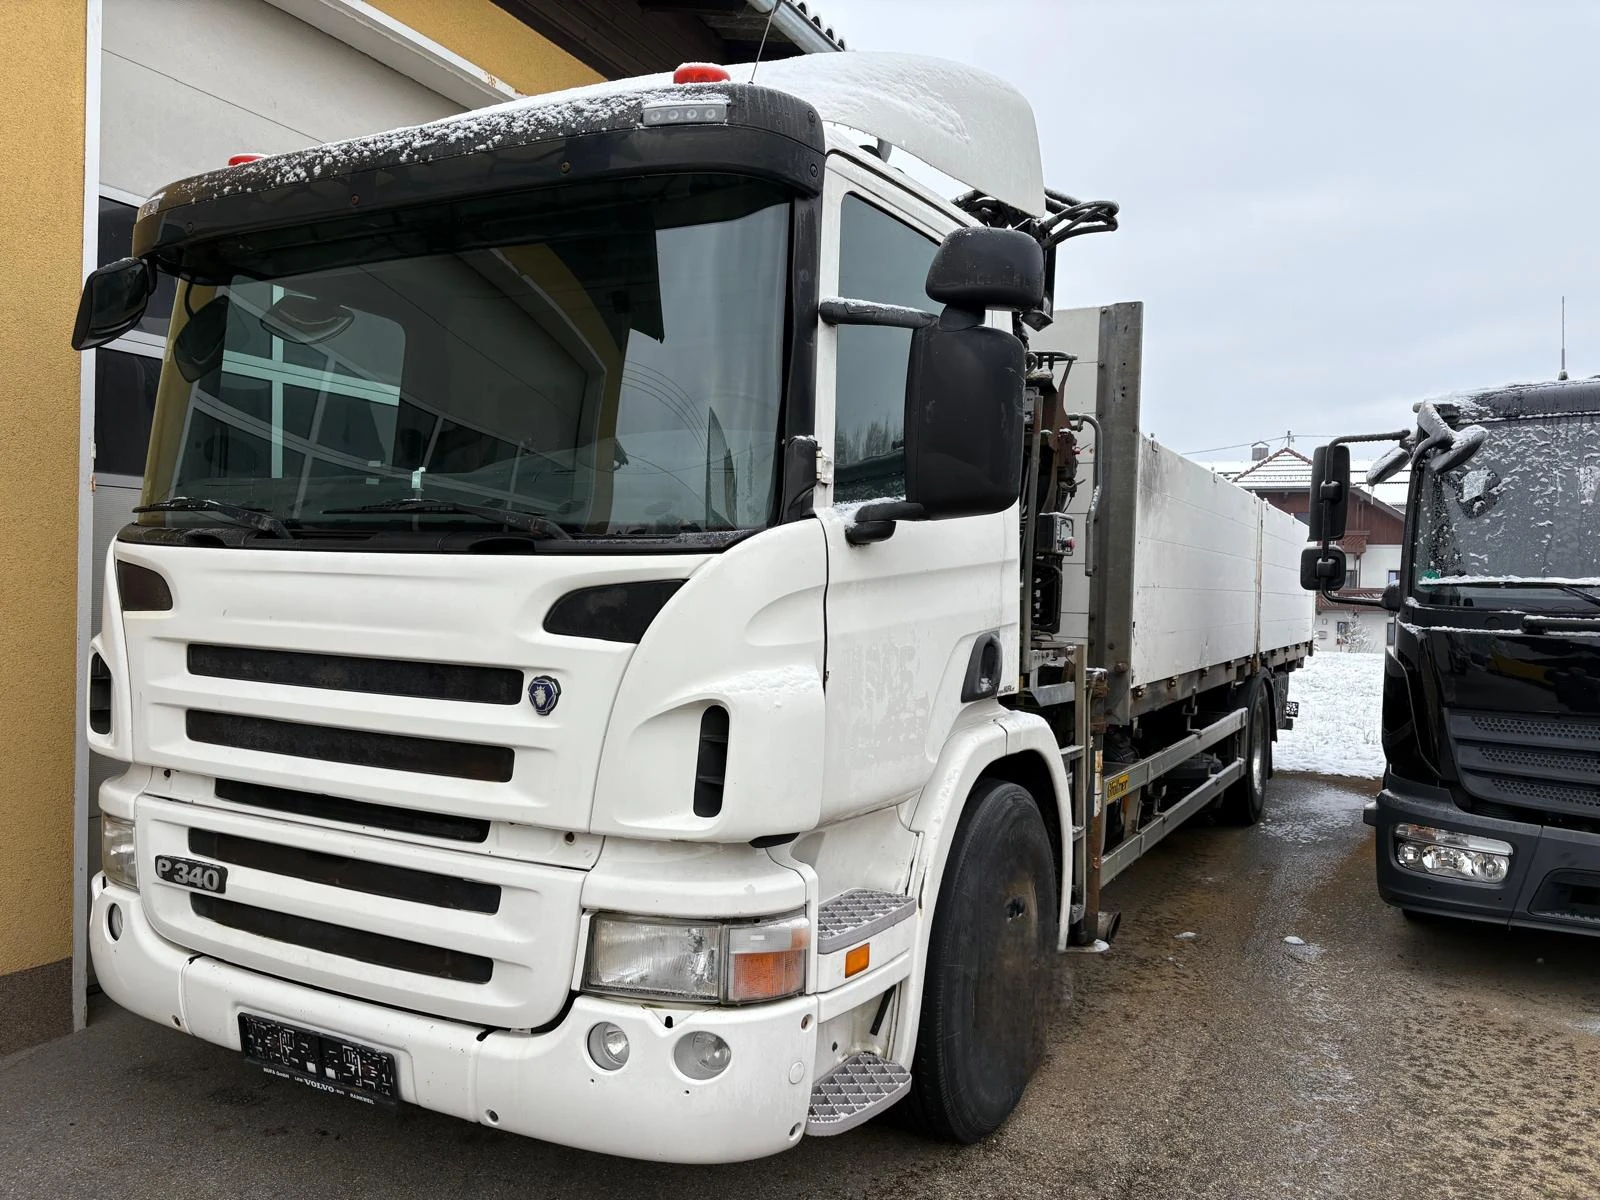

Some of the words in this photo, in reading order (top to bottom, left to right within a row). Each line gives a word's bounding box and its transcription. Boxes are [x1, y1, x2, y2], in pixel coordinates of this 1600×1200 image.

[157, 858, 172, 878] P
[173, 862, 220, 891] 340
[303, 1078, 335, 1093] VOLVO
